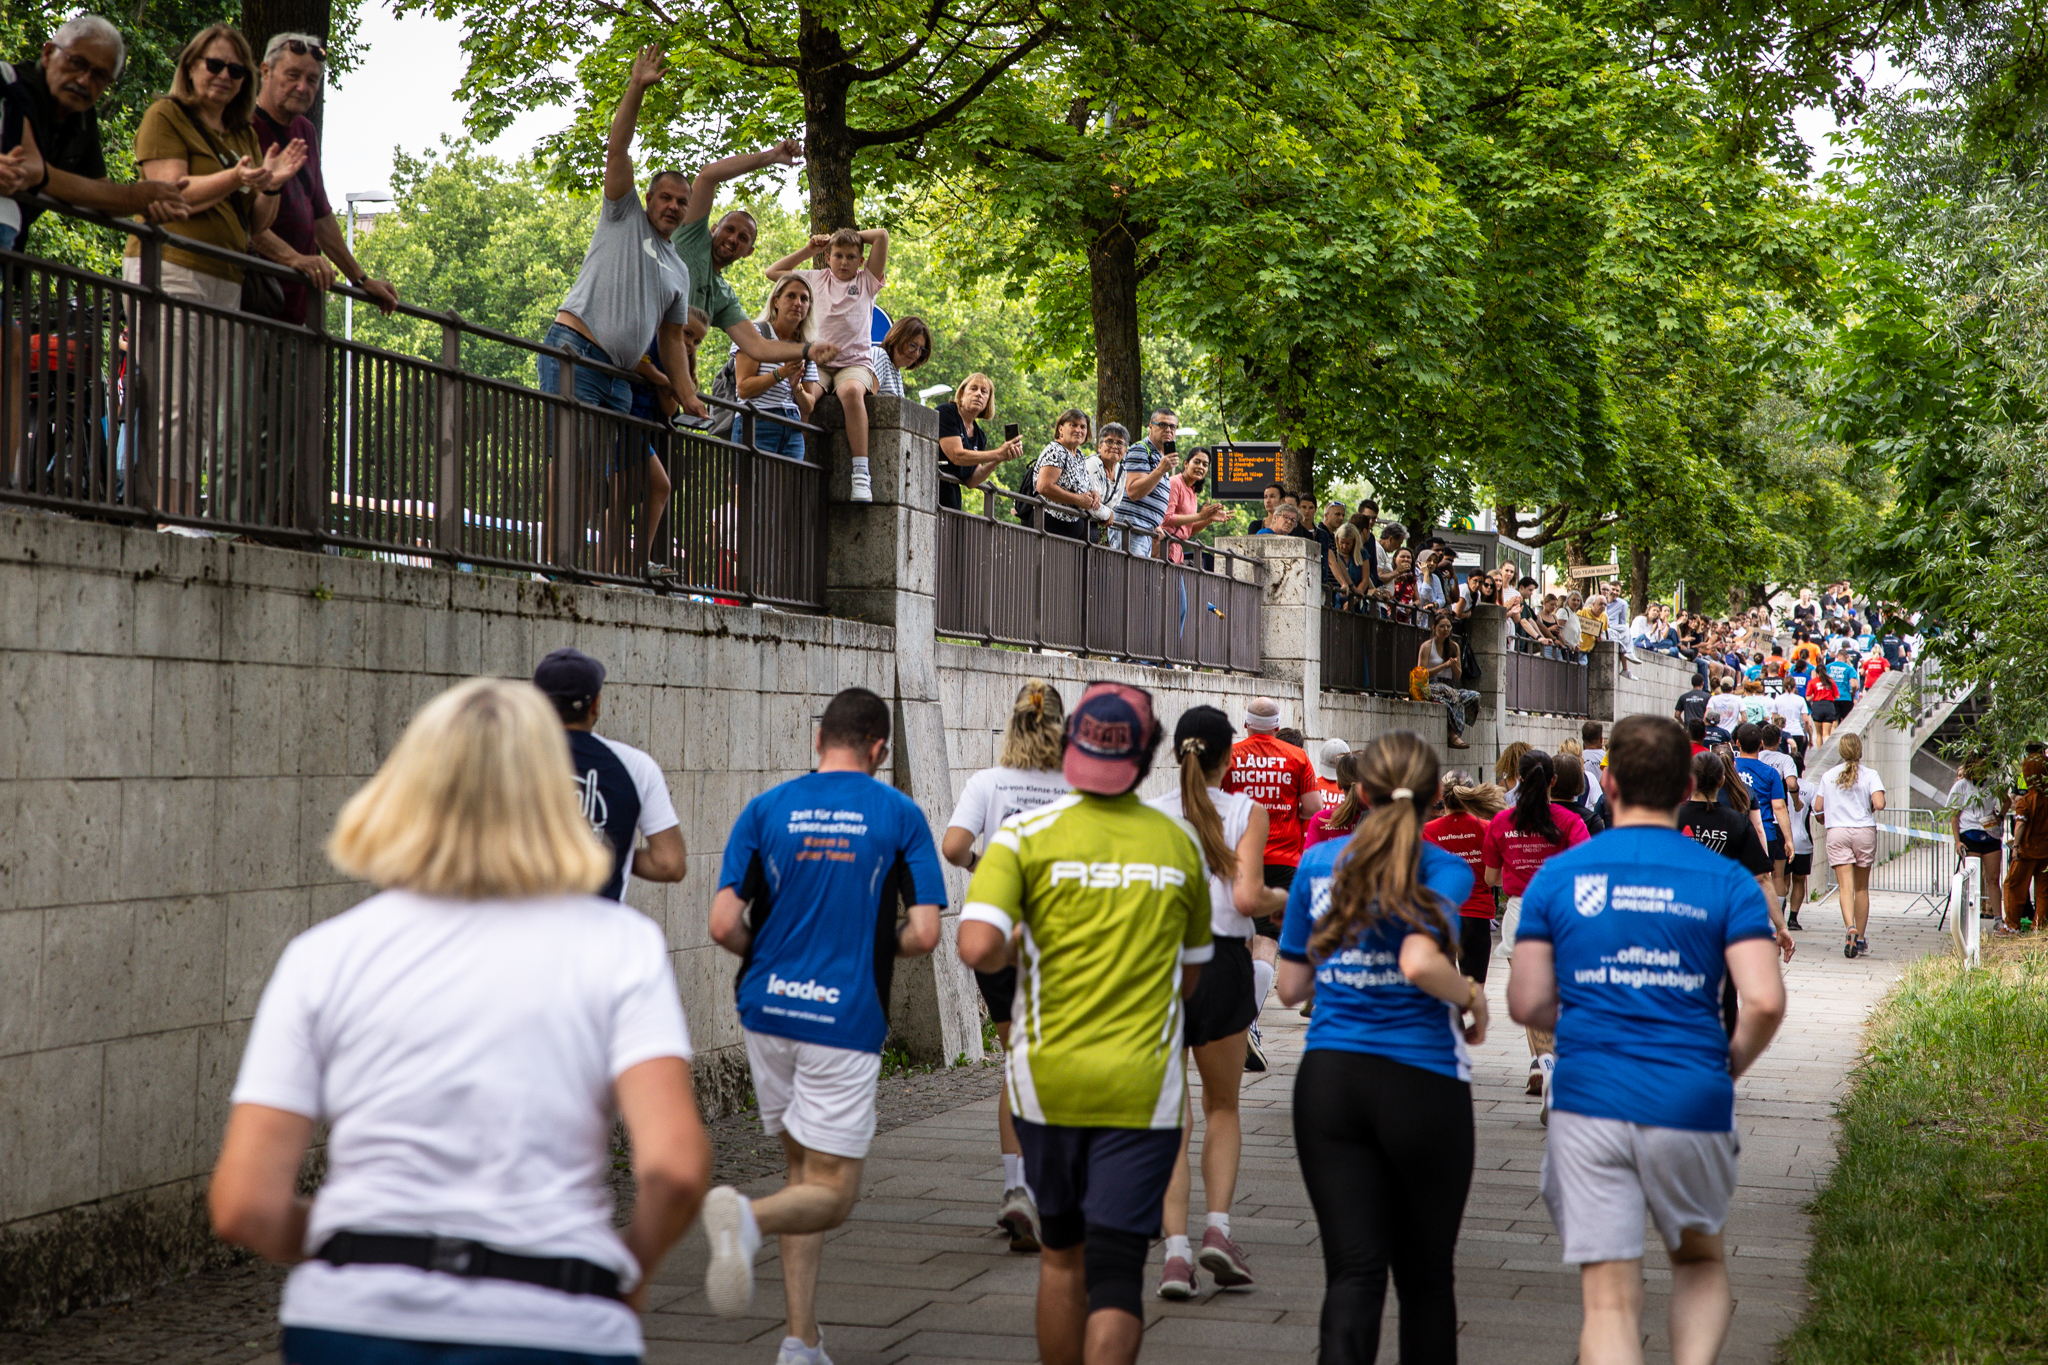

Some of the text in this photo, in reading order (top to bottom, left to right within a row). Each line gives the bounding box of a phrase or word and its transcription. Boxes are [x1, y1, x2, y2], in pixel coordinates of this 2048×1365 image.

[1236, 753, 1287, 769] LÄUFT
[1231, 770, 1292, 785] RICHTIG
[1243, 785, 1280, 799] GUT!
[1260, 802, 1292, 811] AUFLAND
[1438, 833, 1476, 841] kaufland.com
[1050, 860, 1187, 891] ASAP
[1574, 965, 1607, 984] und
[766, 973, 841, 1004] leadec
